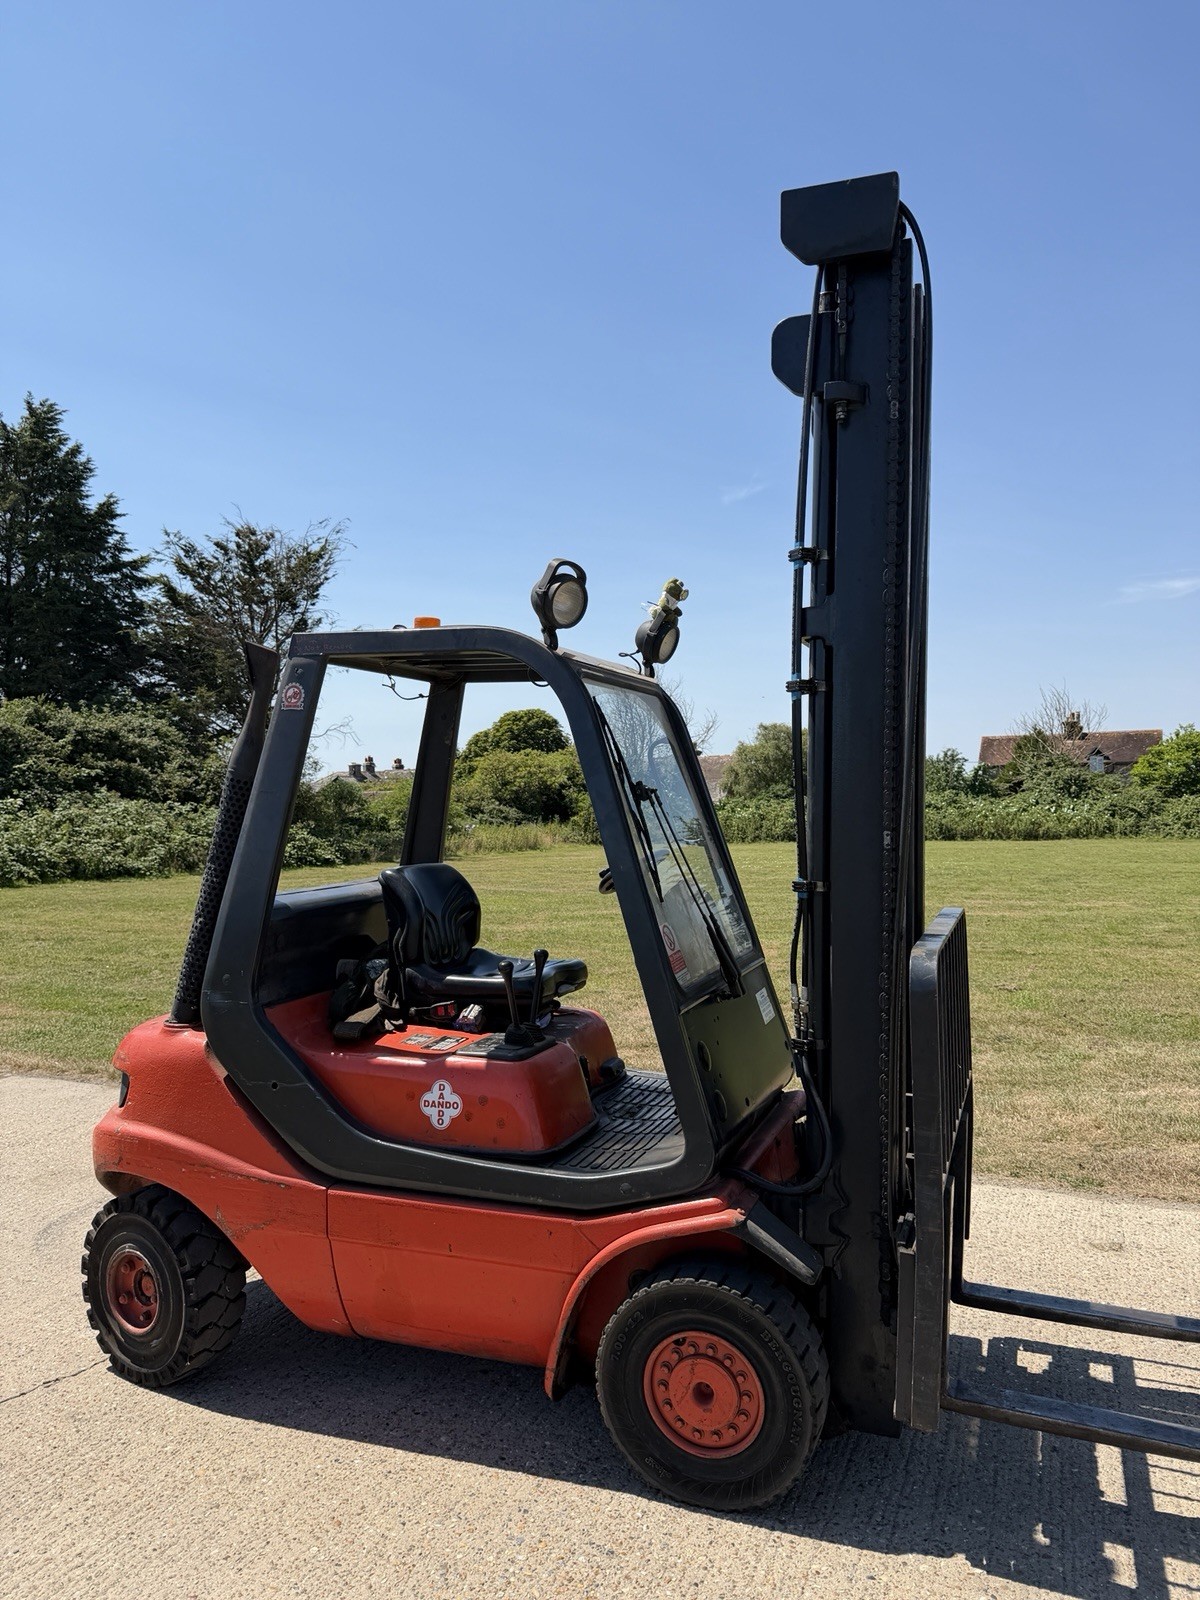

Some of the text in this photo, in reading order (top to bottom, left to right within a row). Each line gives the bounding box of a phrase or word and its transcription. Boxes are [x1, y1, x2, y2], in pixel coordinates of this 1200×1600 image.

[423, 1099, 459, 1110] DANDO
[437, 1083, 446, 1126] DANDO
[759, 1329, 803, 1446] BERGOUGNAN
